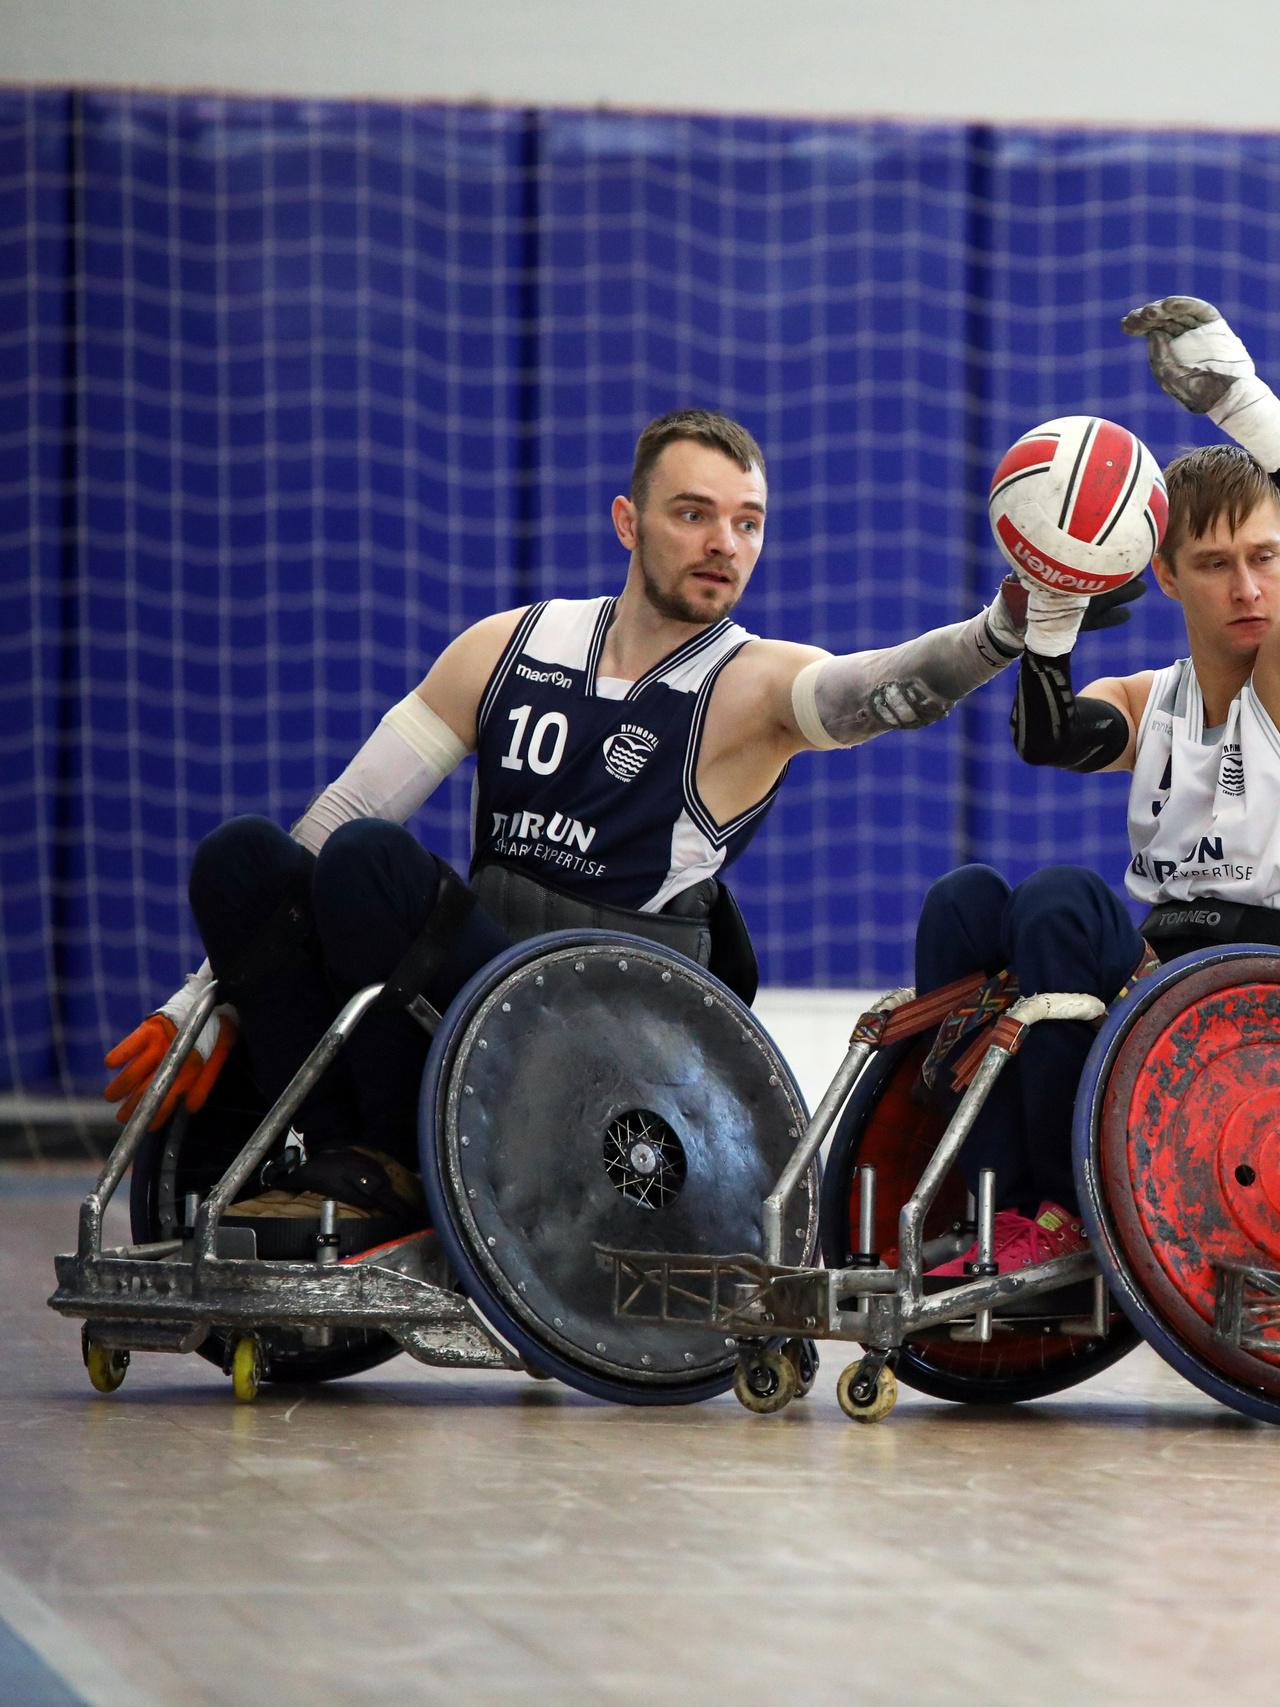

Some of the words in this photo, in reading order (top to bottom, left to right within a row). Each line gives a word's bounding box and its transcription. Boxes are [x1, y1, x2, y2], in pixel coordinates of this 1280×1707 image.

[1013, 541, 1107, 591] molten
[515, 663, 572, 689] macron
[501, 704, 568, 775] 10
[534, 843, 606, 877] EXPERTISE
[1159, 910, 1221, 926] TORNEO
